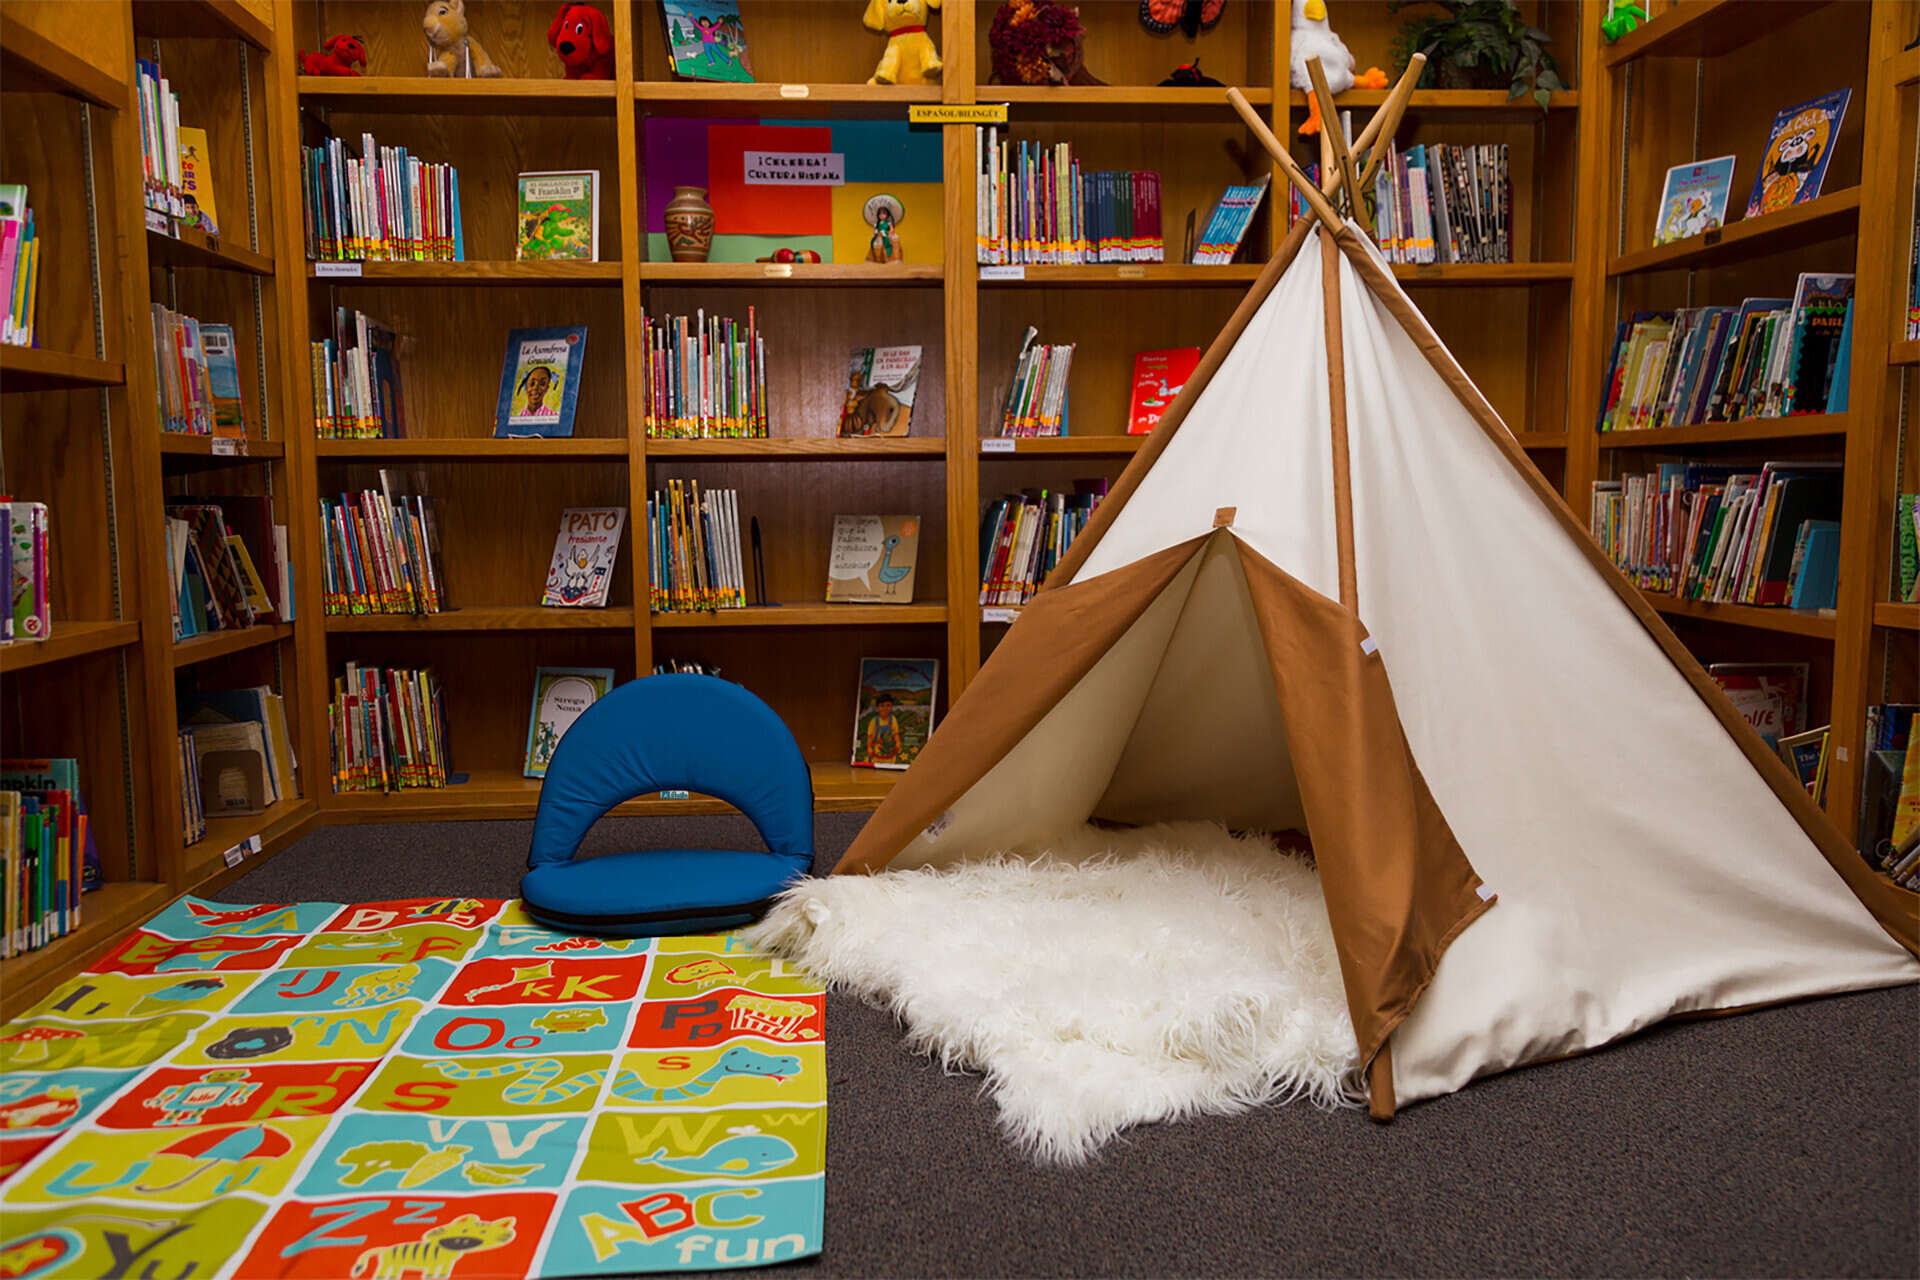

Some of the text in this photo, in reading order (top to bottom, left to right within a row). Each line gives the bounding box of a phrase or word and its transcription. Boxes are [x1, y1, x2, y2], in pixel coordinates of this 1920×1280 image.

[538, 186, 571, 195] Franklin
[567, 511, 617, 533] PATO
[553, 696, 585, 705] Strega
[408, 936, 463, 963] F
[557, 975, 623, 999] K
[659, 1000, 719, 1030] P
[433, 1016, 506, 1052] O
[250, 1086, 338, 1121] R
[382, 1081, 459, 1112] S
[616, 1115, 727, 1155] W
[45, 1161, 153, 1195] U
[279, 1200, 391, 1258] Z
[578, 1187, 766, 1263] ABC
[675, 1231, 807, 1265] fun
